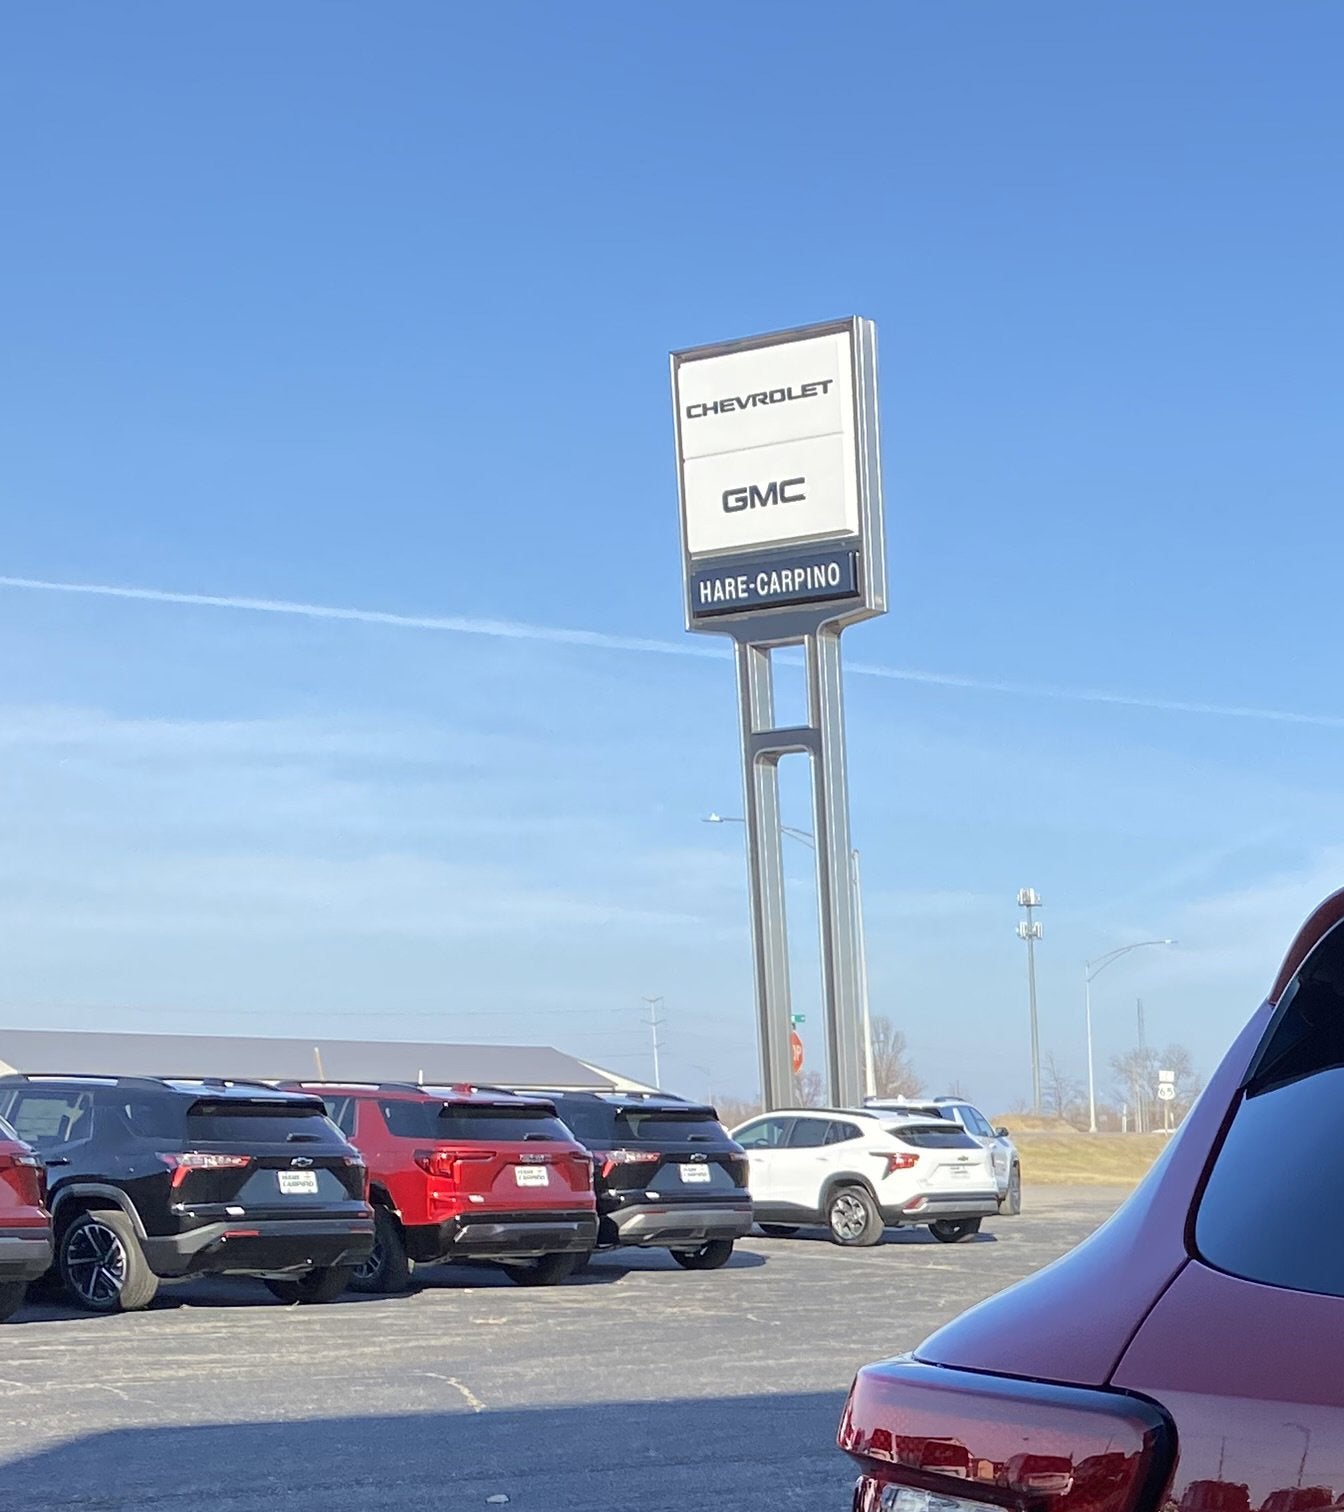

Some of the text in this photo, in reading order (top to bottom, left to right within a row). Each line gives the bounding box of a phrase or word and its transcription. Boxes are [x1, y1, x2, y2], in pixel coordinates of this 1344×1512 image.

[686, 379, 833, 419] CHEVROLET
[722, 477, 806, 513] GMC
[699, 562, 840, 605] HARE-CARPINO
